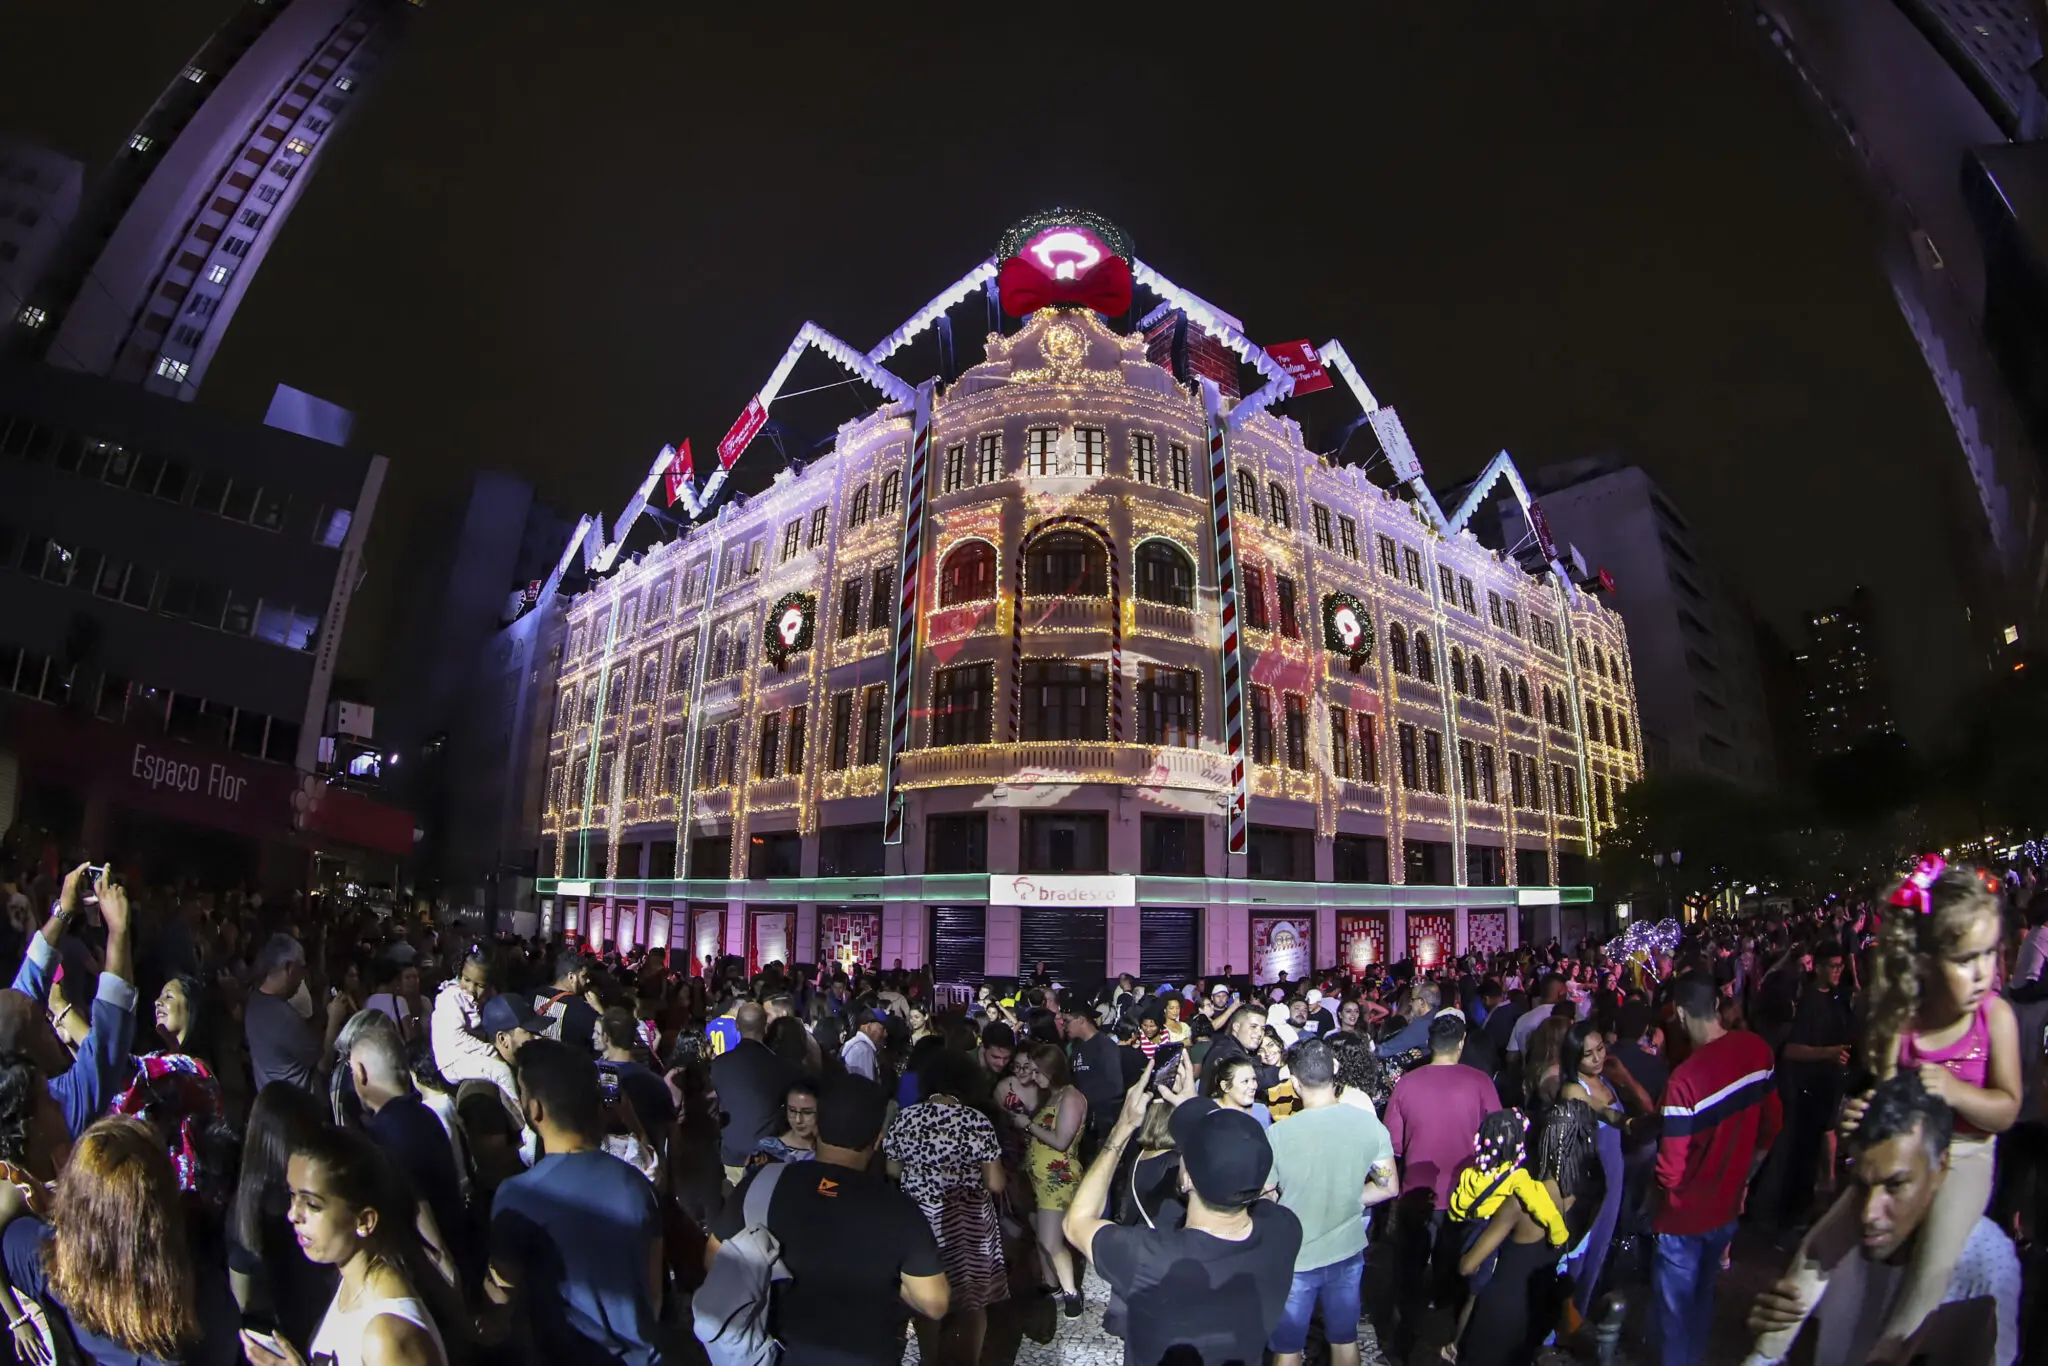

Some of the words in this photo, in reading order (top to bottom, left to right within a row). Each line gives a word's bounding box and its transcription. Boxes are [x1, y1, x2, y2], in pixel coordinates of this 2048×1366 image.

[132, 743, 200, 792] Espaço
[207, 763, 248, 802] Flor
[1039, 886, 1116, 901] bradesco
